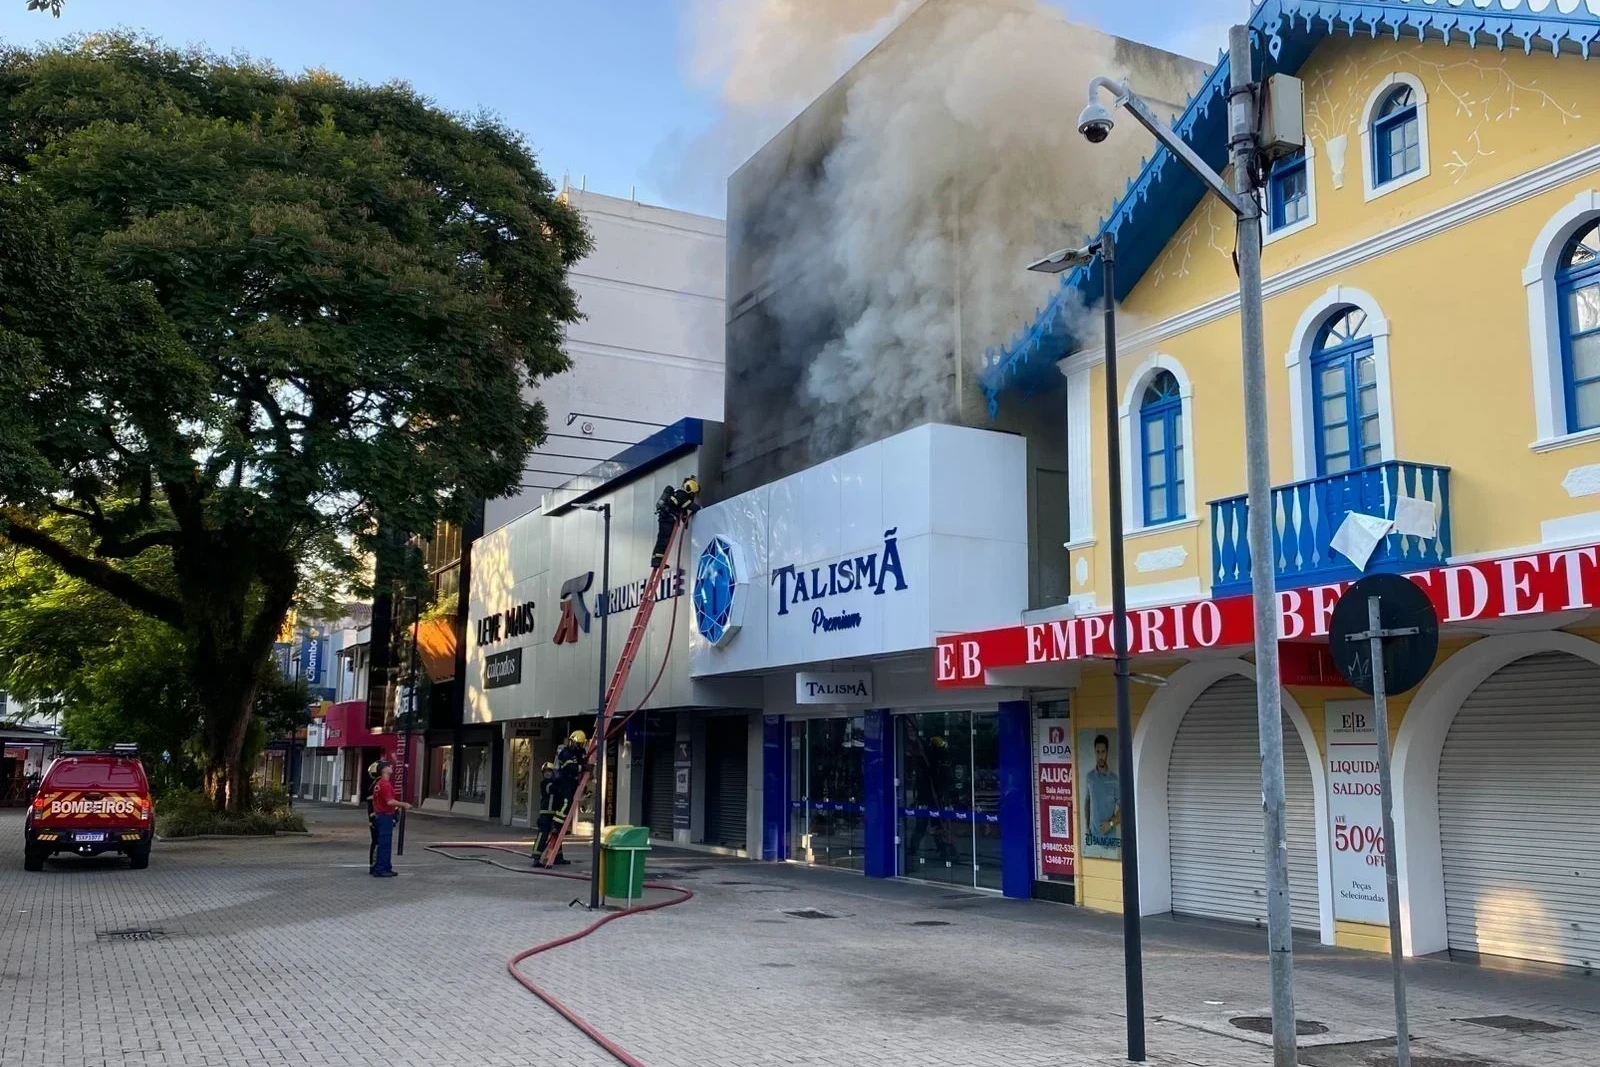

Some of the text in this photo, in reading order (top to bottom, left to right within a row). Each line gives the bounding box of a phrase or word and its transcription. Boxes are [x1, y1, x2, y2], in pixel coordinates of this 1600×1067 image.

[771, 527, 908, 615] TALISMÃ
[1276, 546, 1598, 640] BEDET
[477, 601, 535, 647] LEVE MAIS
[811, 606, 862, 634] Premium
[307, 639, 318, 681] Colombo
[486, 655, 516, 682] calçados
[806, 679, 868, 697] TALISMÃ
[1043, 745, 1071, 754] DUDA
[1330, 761, 1380, 774] LIQUIDA
[1333, 782, 1381, 795] SALDOS
[51, 800, 135, 814] BOMBEIROS
[1335, 824, 1385, 854] 50%
[1340, 891, 1385, 902] Selecionadas
[1352, 881, 1372, 891] Peças
